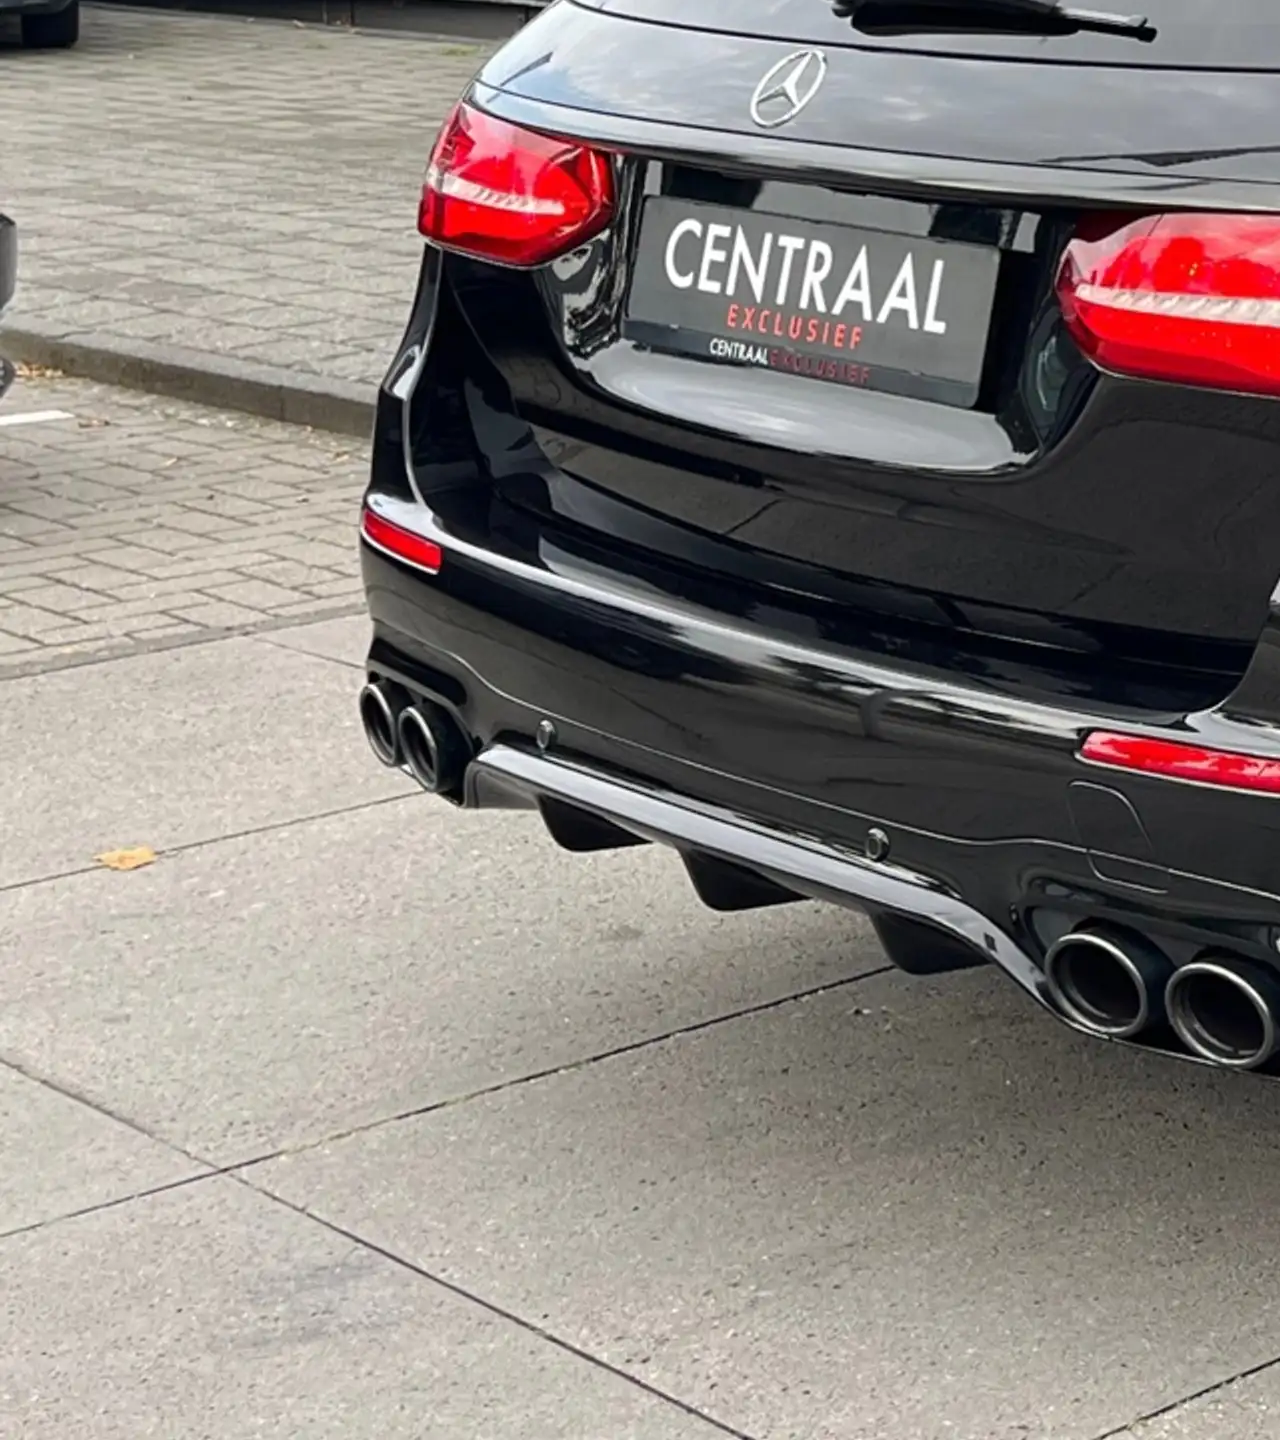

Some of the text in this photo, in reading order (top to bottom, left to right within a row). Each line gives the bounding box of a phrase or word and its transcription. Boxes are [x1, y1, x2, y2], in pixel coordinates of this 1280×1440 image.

[664, 218, 947, 335] CENTRAAL
[727, 304, 863, 350] EXCLUSIEF
[709, 337, 871, 385] CENTRAAL EXCLUSIEF
